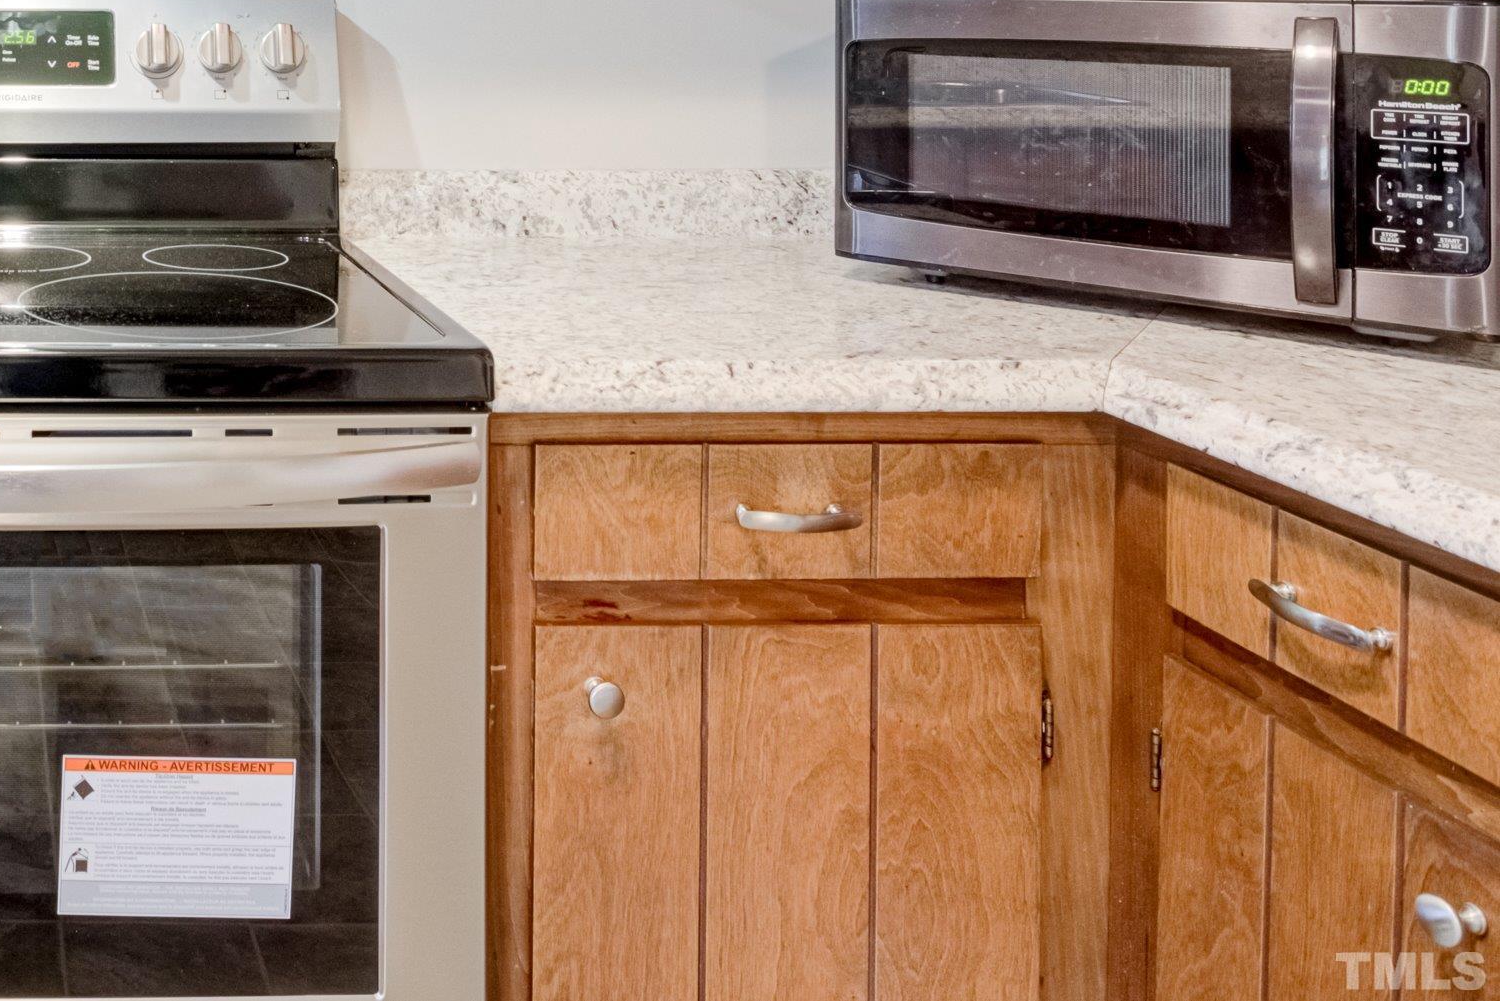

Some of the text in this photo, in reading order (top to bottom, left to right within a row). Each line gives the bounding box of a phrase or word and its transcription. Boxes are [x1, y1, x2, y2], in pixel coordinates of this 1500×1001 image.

[1404, 79, 1450, 96] 0:00
[1416, 184, 1423, 192] 2
[1447, 186, 1453, 194] 3
[1386, 198, 1393, 206] 4
[99, 759, 159, 771] WARNING
[170, 762, 275, 773] AVERTISSEMENT
